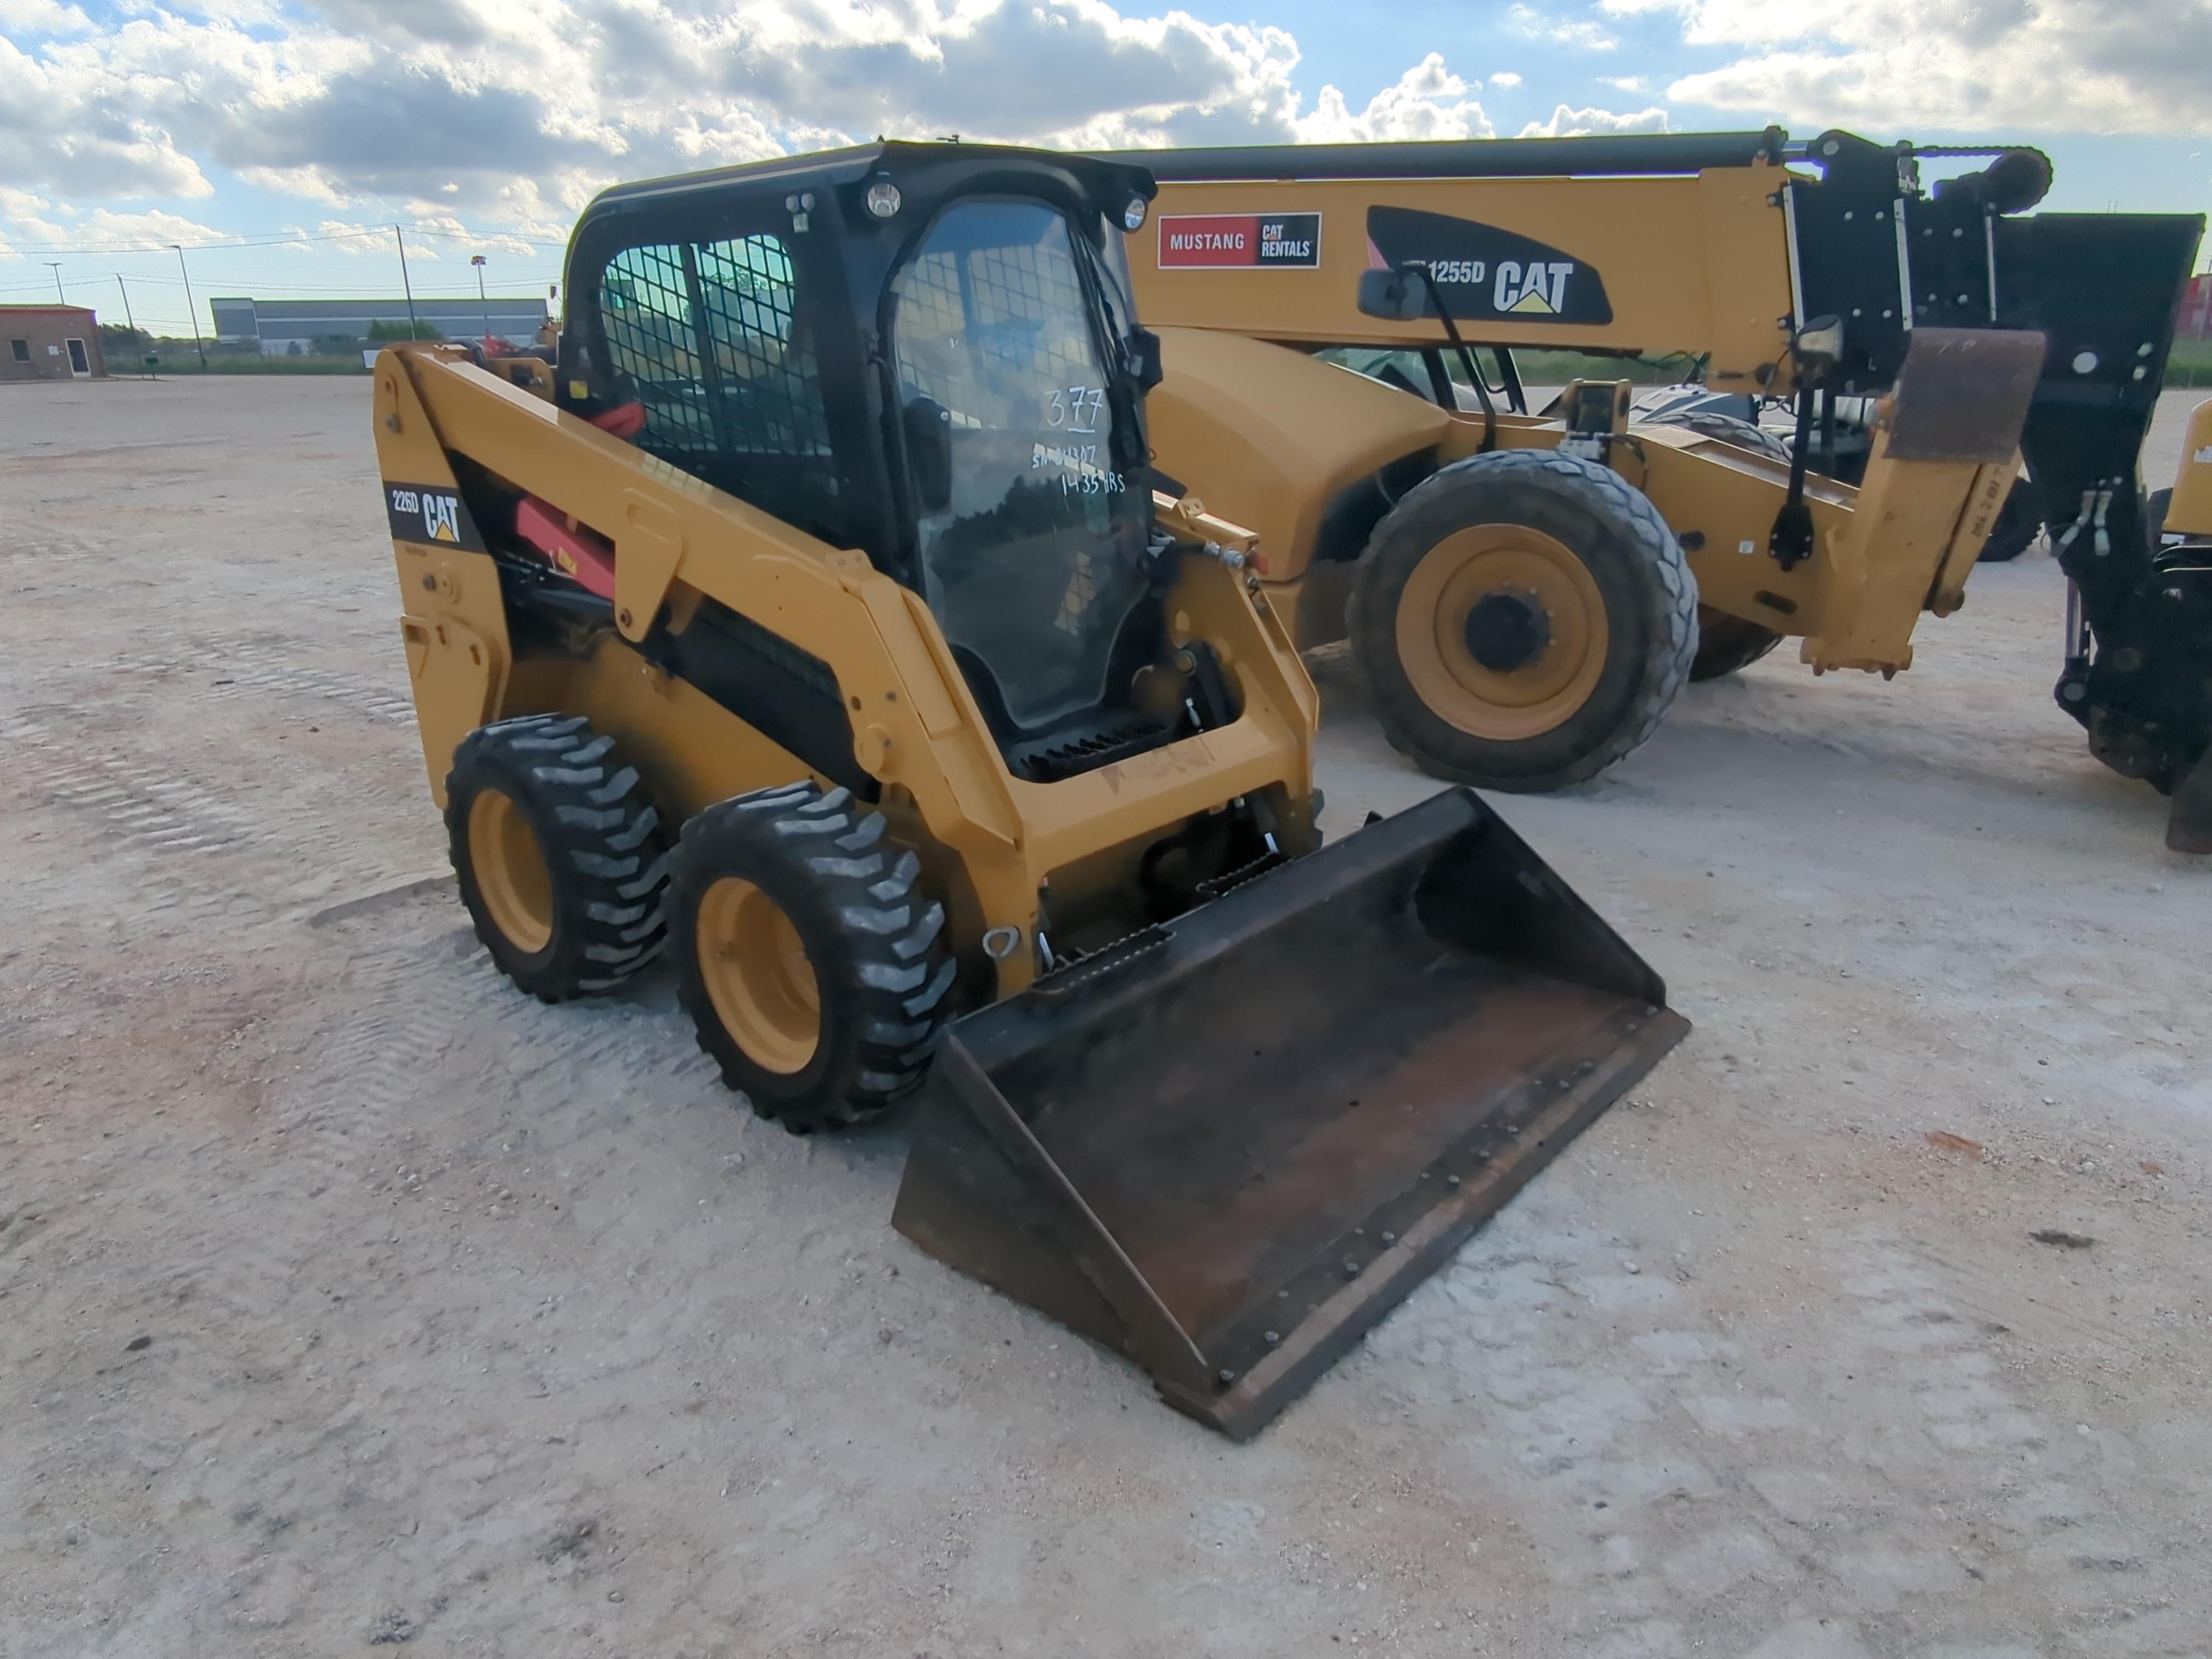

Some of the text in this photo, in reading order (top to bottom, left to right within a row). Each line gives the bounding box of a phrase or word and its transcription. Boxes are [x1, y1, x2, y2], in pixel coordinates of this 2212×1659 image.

[1170, 233, 1245, 250] MUSTANG
[1262, 224, 1284, 240] CAT
[1261, 240, 1311, 257] RENTALS
[1493, 261, 1574, 314] CAT
[1044, 386, 1104, 427] 377
[1062, 473, 1099, 496] 1435
[392, 489, 460, 543] 226D CAT
